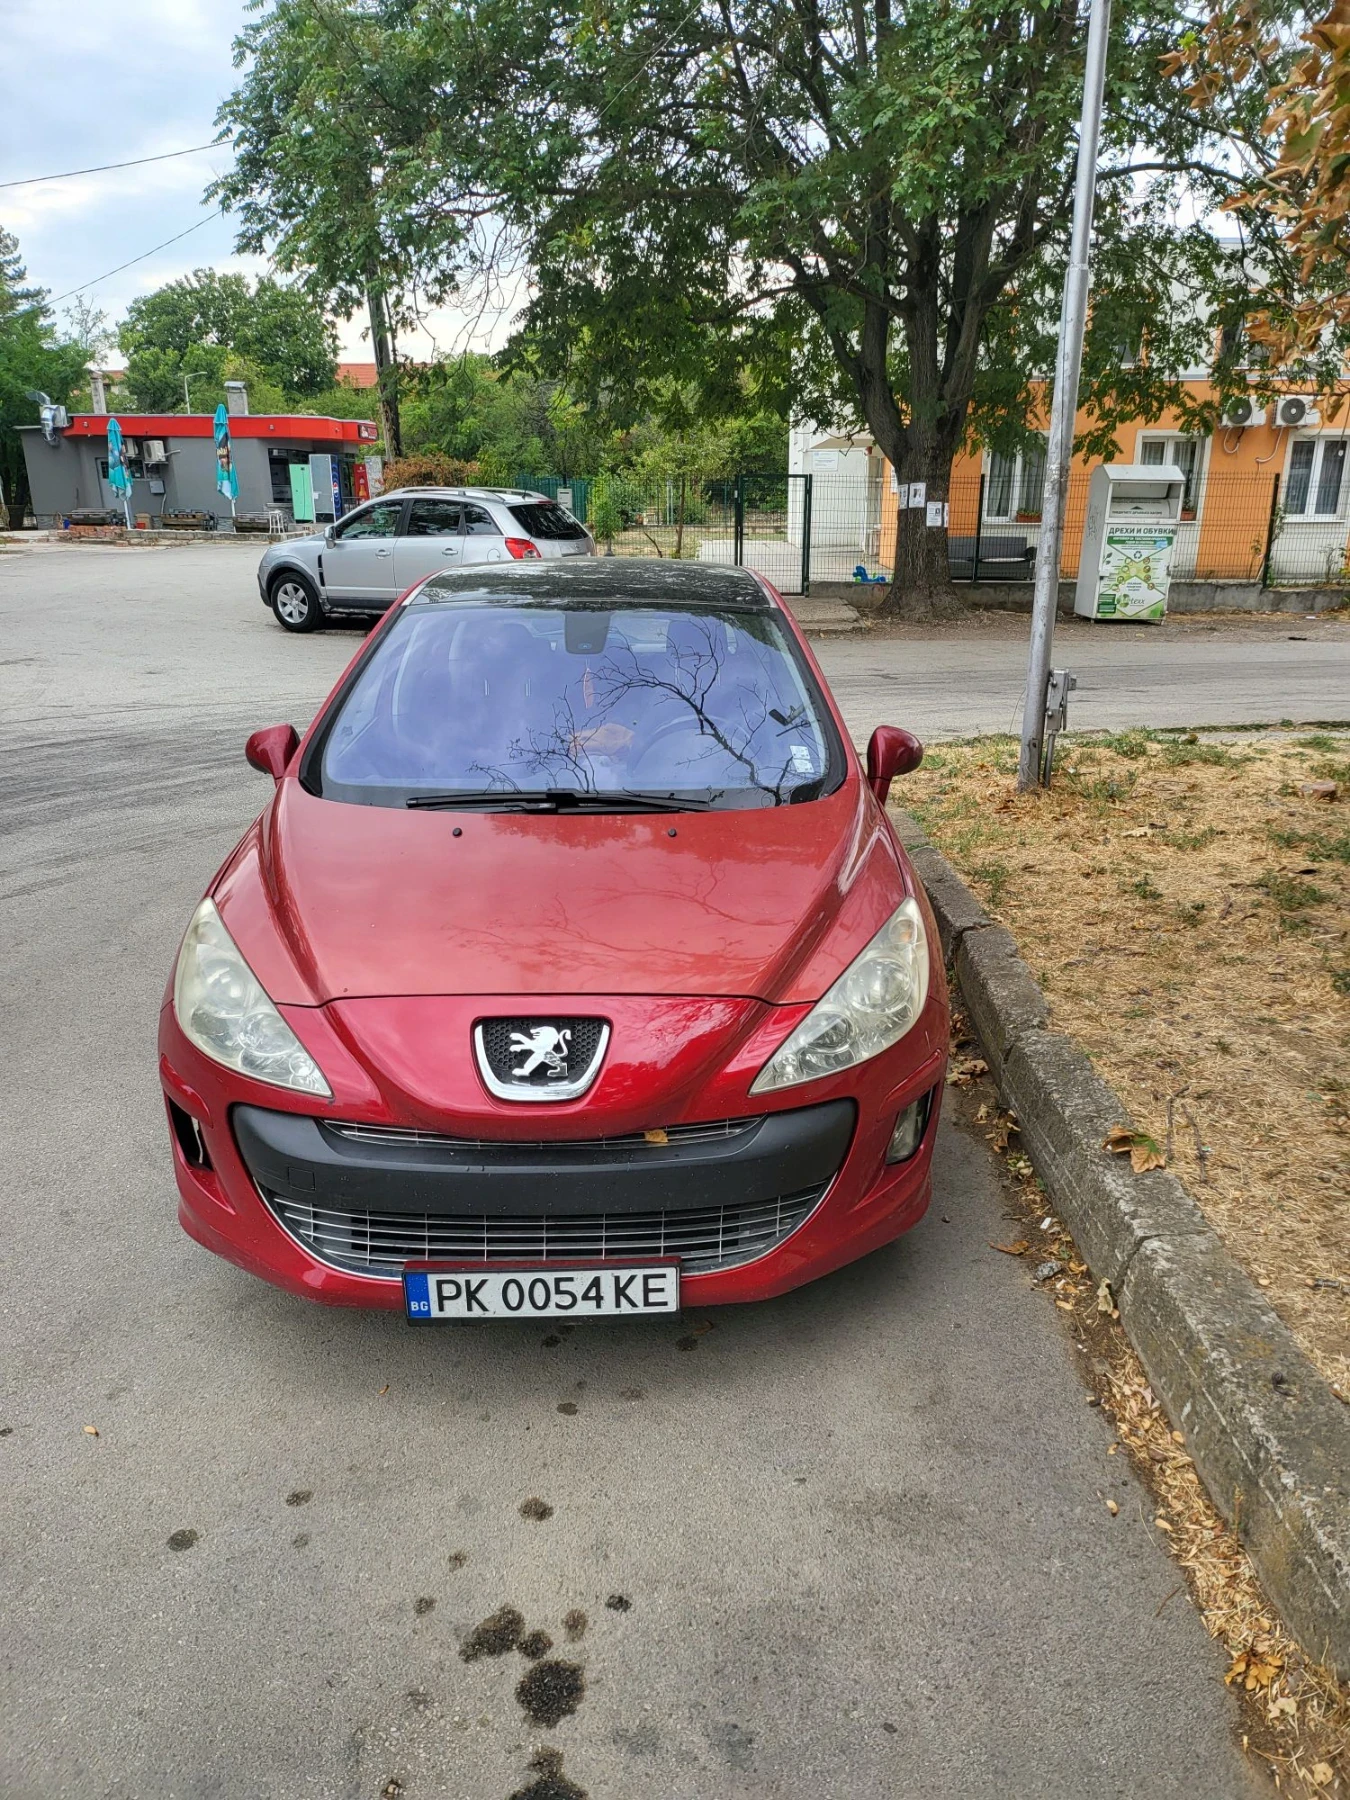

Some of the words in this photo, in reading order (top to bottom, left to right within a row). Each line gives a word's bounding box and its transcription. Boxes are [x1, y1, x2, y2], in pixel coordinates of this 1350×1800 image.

[1109, 527, 1135, 535] ДРЕХИ
[1143, 527, 1174, 535] ОБУВКИ
[435, 1278, 490, 1312] PK
[501, 1275, 604, 1311] 0054
[614, 1273, 668, 1309] KE
[411, 1301, 429, 1312] BG
